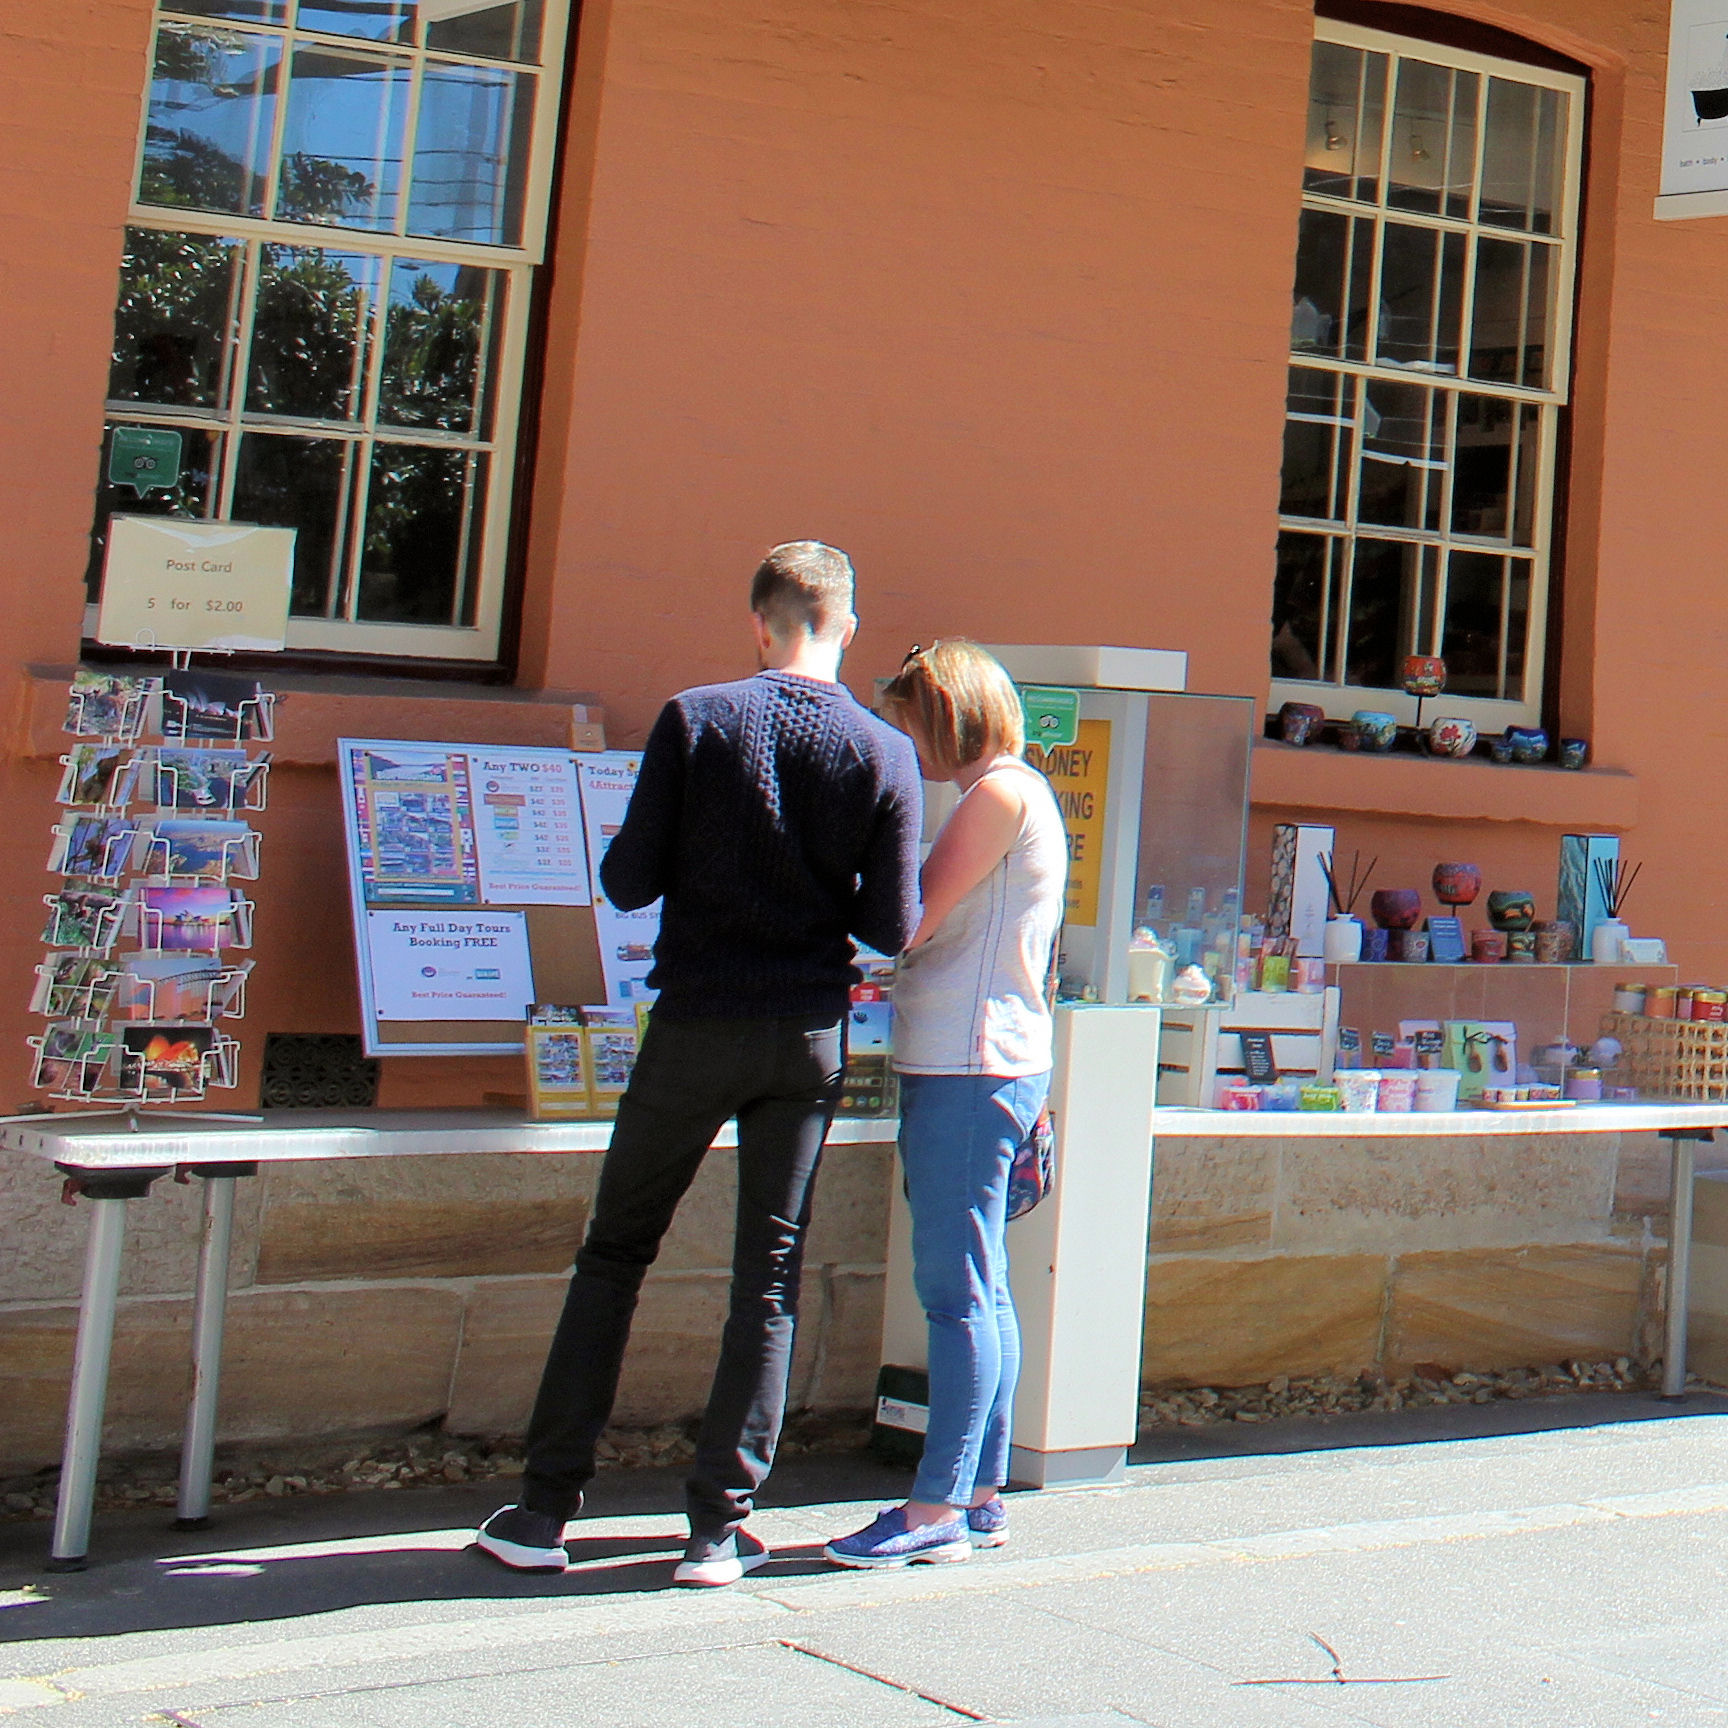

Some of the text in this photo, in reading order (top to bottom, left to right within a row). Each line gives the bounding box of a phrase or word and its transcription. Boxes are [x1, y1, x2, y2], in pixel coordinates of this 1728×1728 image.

[166, 559, 233, 574] Post Card
[147, 597, 243, 613] 5 for $2.00
[483, 761, 507, 773] Any
[509, 762, 540, 773] TWO
[393, 922, 511, 935] Any Full Day Tours
[409, 937, 498, 949] Booking FREE
